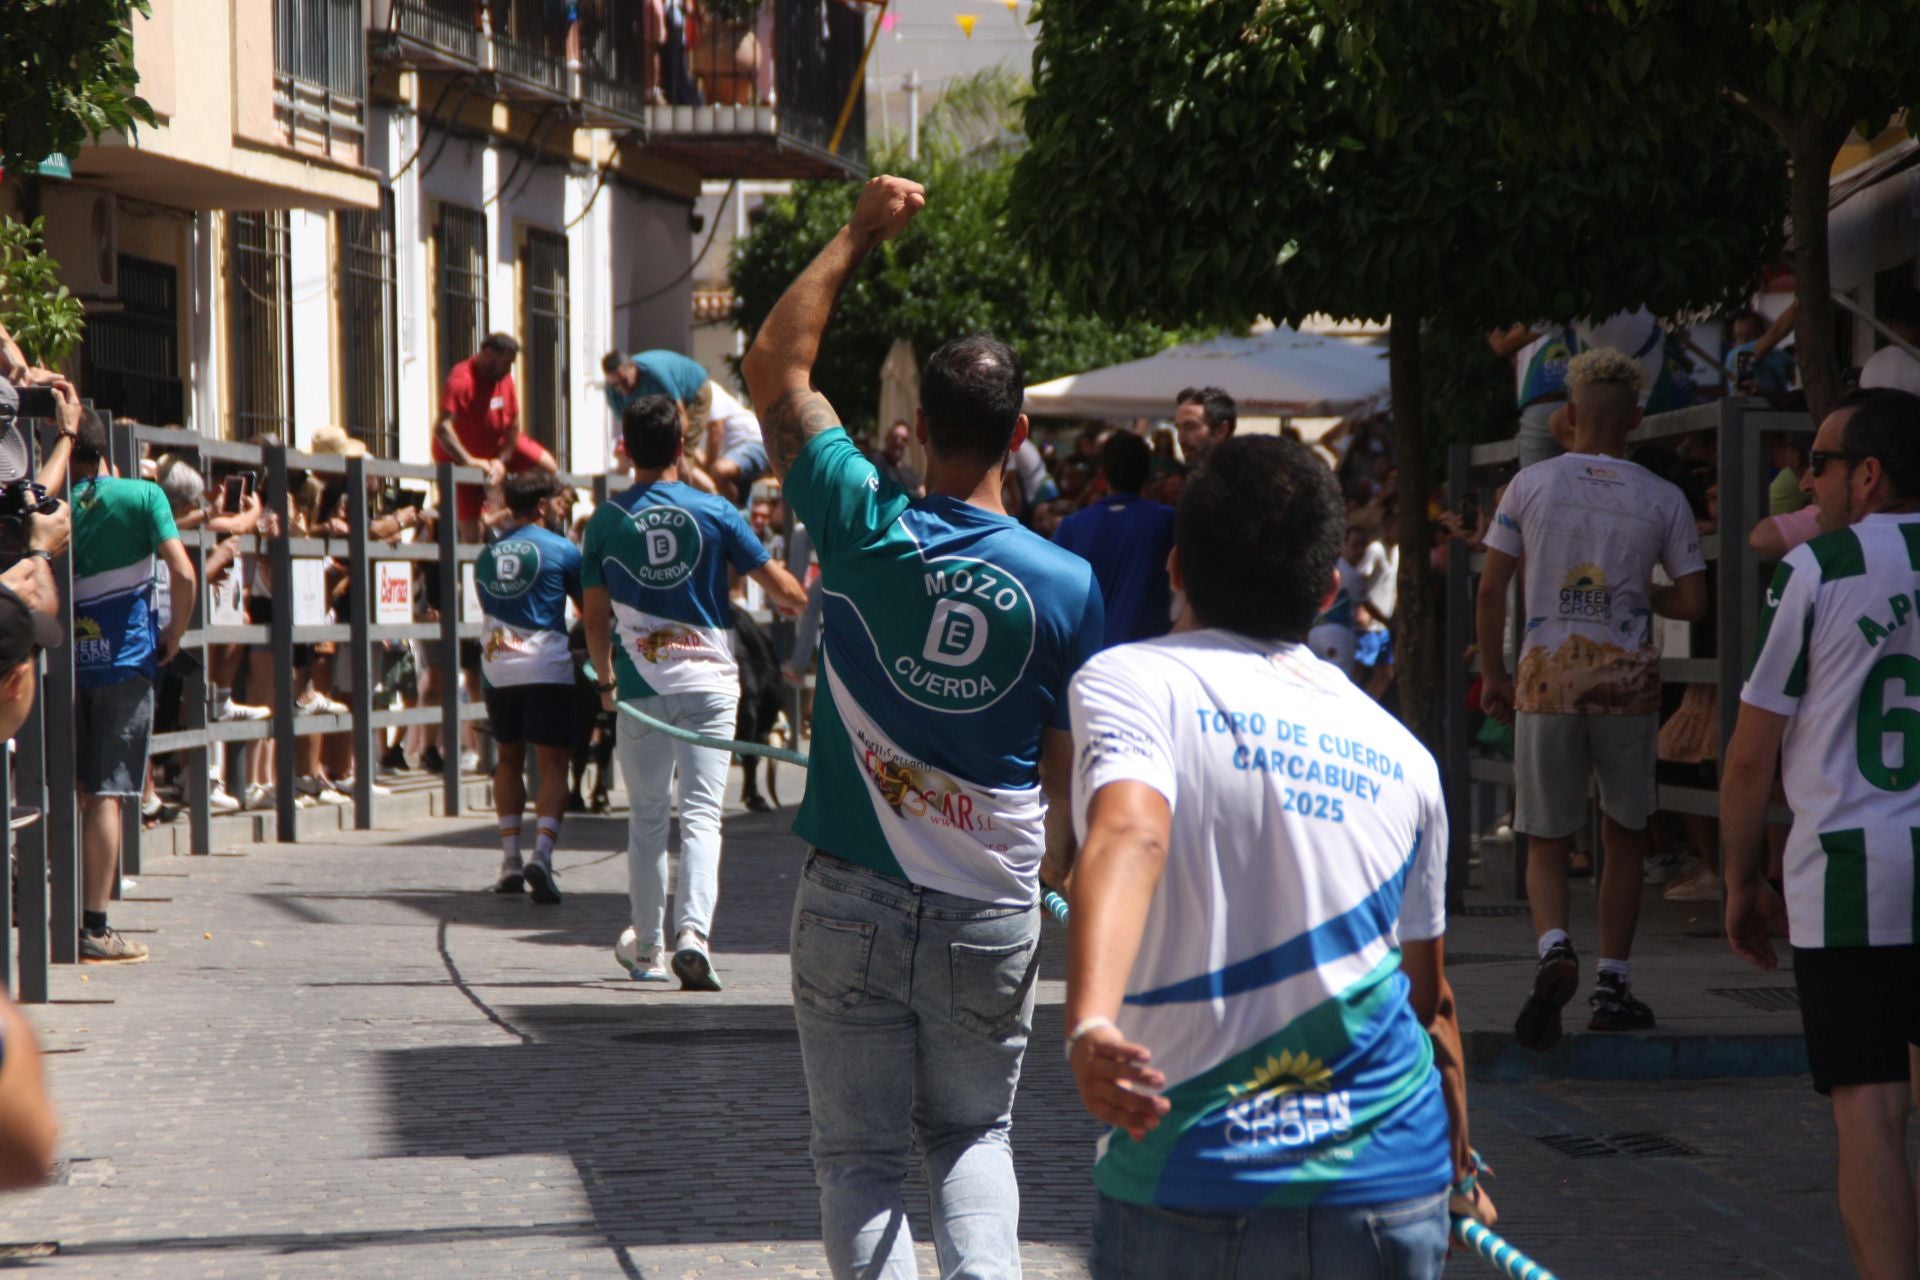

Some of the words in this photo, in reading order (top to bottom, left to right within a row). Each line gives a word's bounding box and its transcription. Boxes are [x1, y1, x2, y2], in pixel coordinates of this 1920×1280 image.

[634, 510, 685, 534] MOZO
[639, 561, 690, 582] CUERDA
[924, 569, 1018, 612] MOZO
[1560, 588, 1613, 606] GREEN
[1559, 601, 1613, 620] CROPS
[895, 656, 996, 699] CUERDA
[1857, 653, 1920, 792] 6
[1196, 709, 1267, 736] TORO
[1277, 720, 1309, 747] DE
[1319, 733, 1405, 784] CUERDA
[1232, 745, 1382, 804] CARCABUEY
[1283, 787, 1345, 823] 2025
[1225, 1116, 1352, 1147] CROPS
